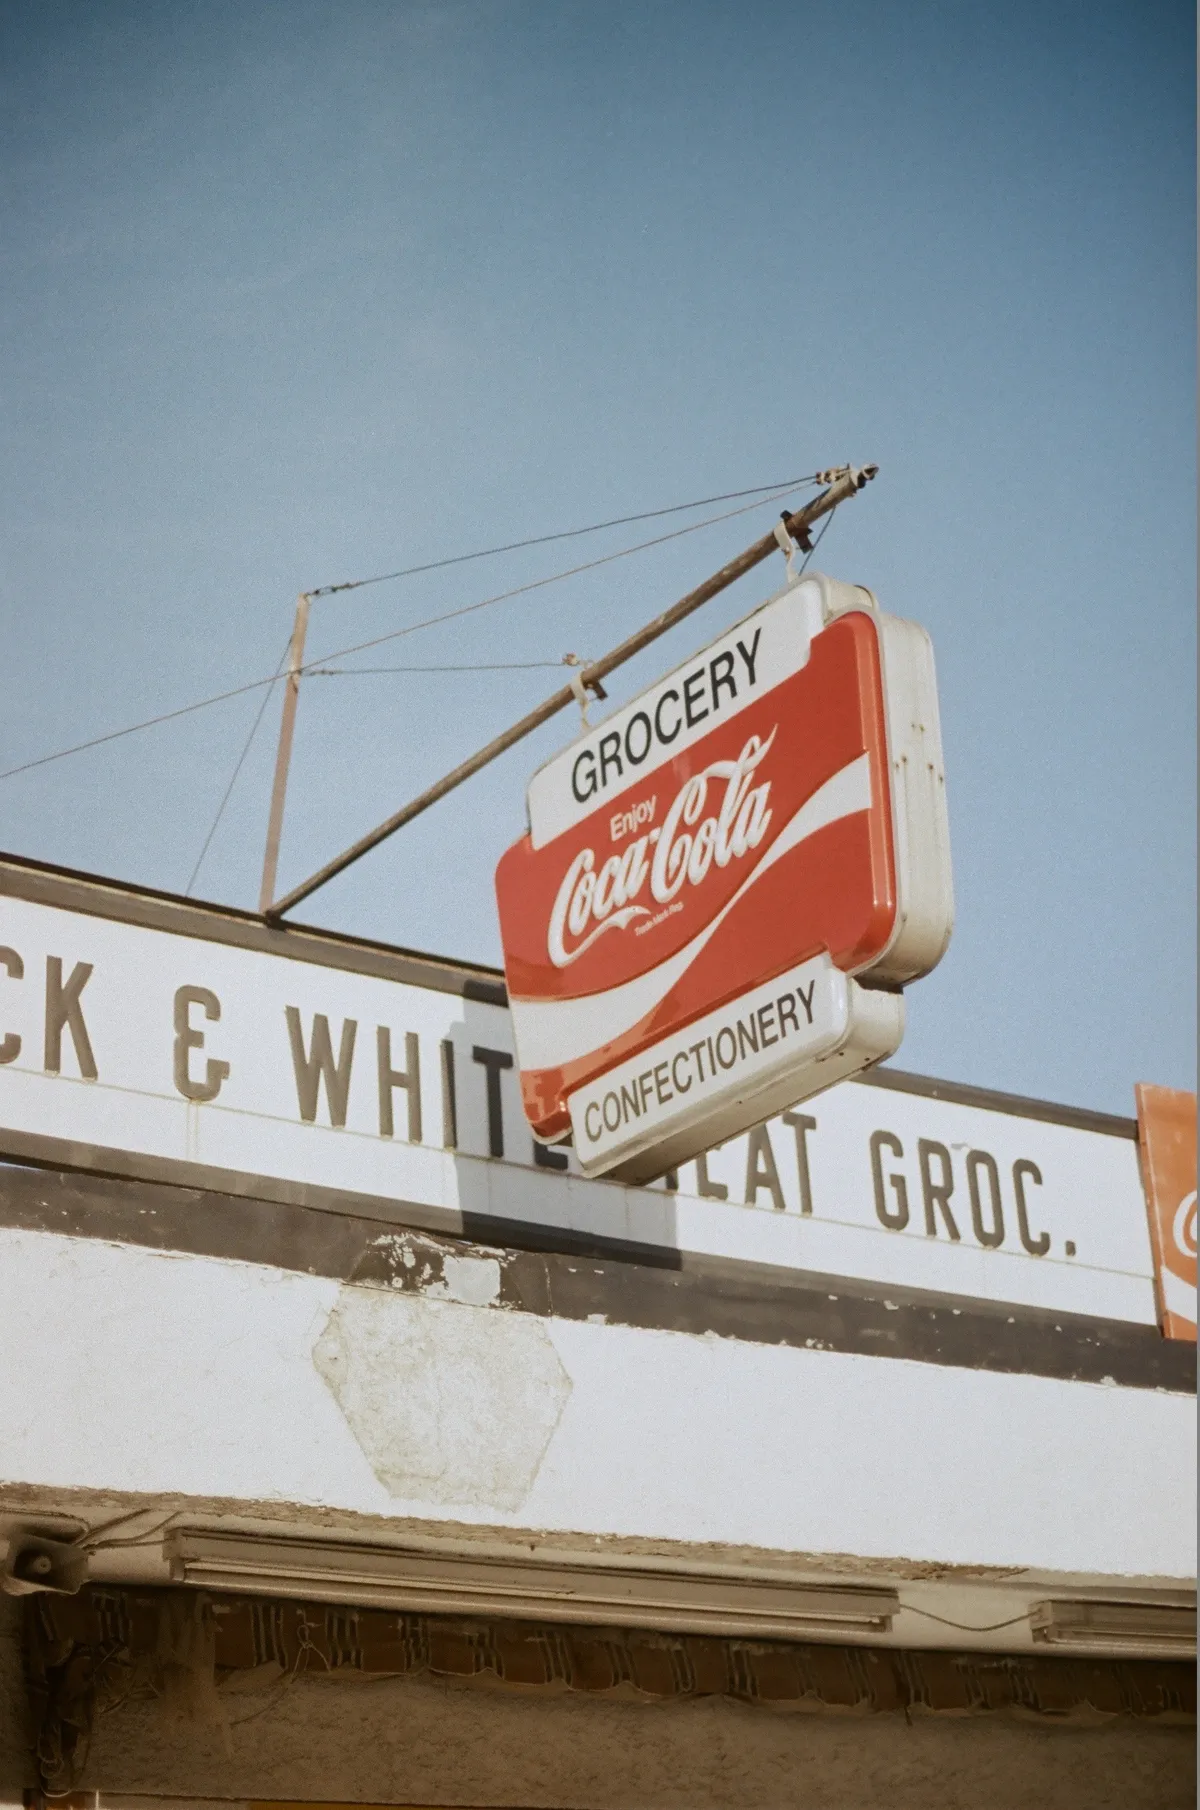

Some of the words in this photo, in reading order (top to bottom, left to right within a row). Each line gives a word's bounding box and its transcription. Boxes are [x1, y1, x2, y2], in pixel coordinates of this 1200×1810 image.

[572, 628, 763, 803] GROCERY
[548, 724, 778, 968] Coca-Cola
[610, 795, 657, 841] Enjoy
[173, 984, 230, 1102] &
[869, 1129, 1076, 1257] GROC.
[585, 979, 817, 1143] CONFECTIONERY
